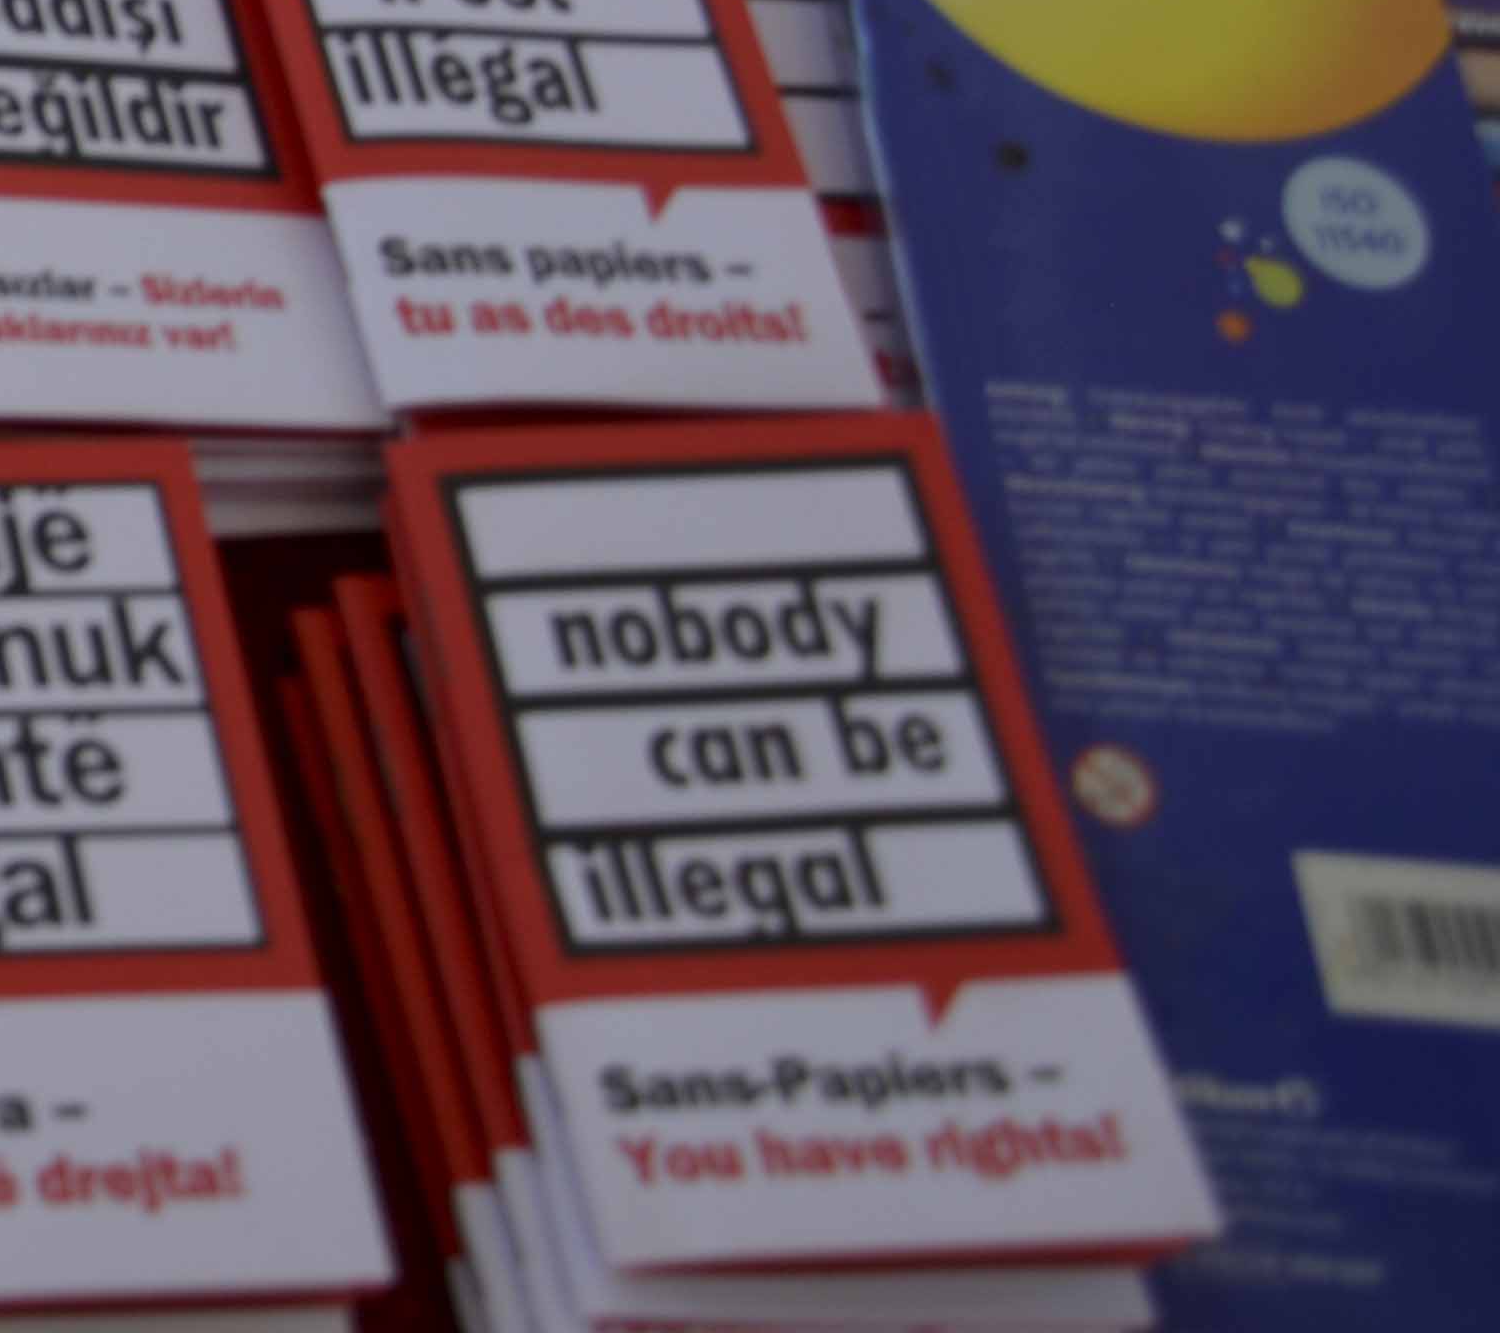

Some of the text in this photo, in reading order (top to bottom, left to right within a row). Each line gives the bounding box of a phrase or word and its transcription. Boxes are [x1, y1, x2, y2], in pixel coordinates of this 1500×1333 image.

[344, 32, 600, 126] illégal
[380, 236, 712, 289] Sans papiers
[394, 296, 807, 345] tu as des droits!
[551, 584, 882, 678] nobody
[648, 699, 946, 789] can be
[581, 829, 886, 938] illegal
[601, 1055, 1010, 1112] Sans-Papiers
[38, 1150, 246, 1215] drejta!
[620, 1115, 1125, 1186] You have rights!
